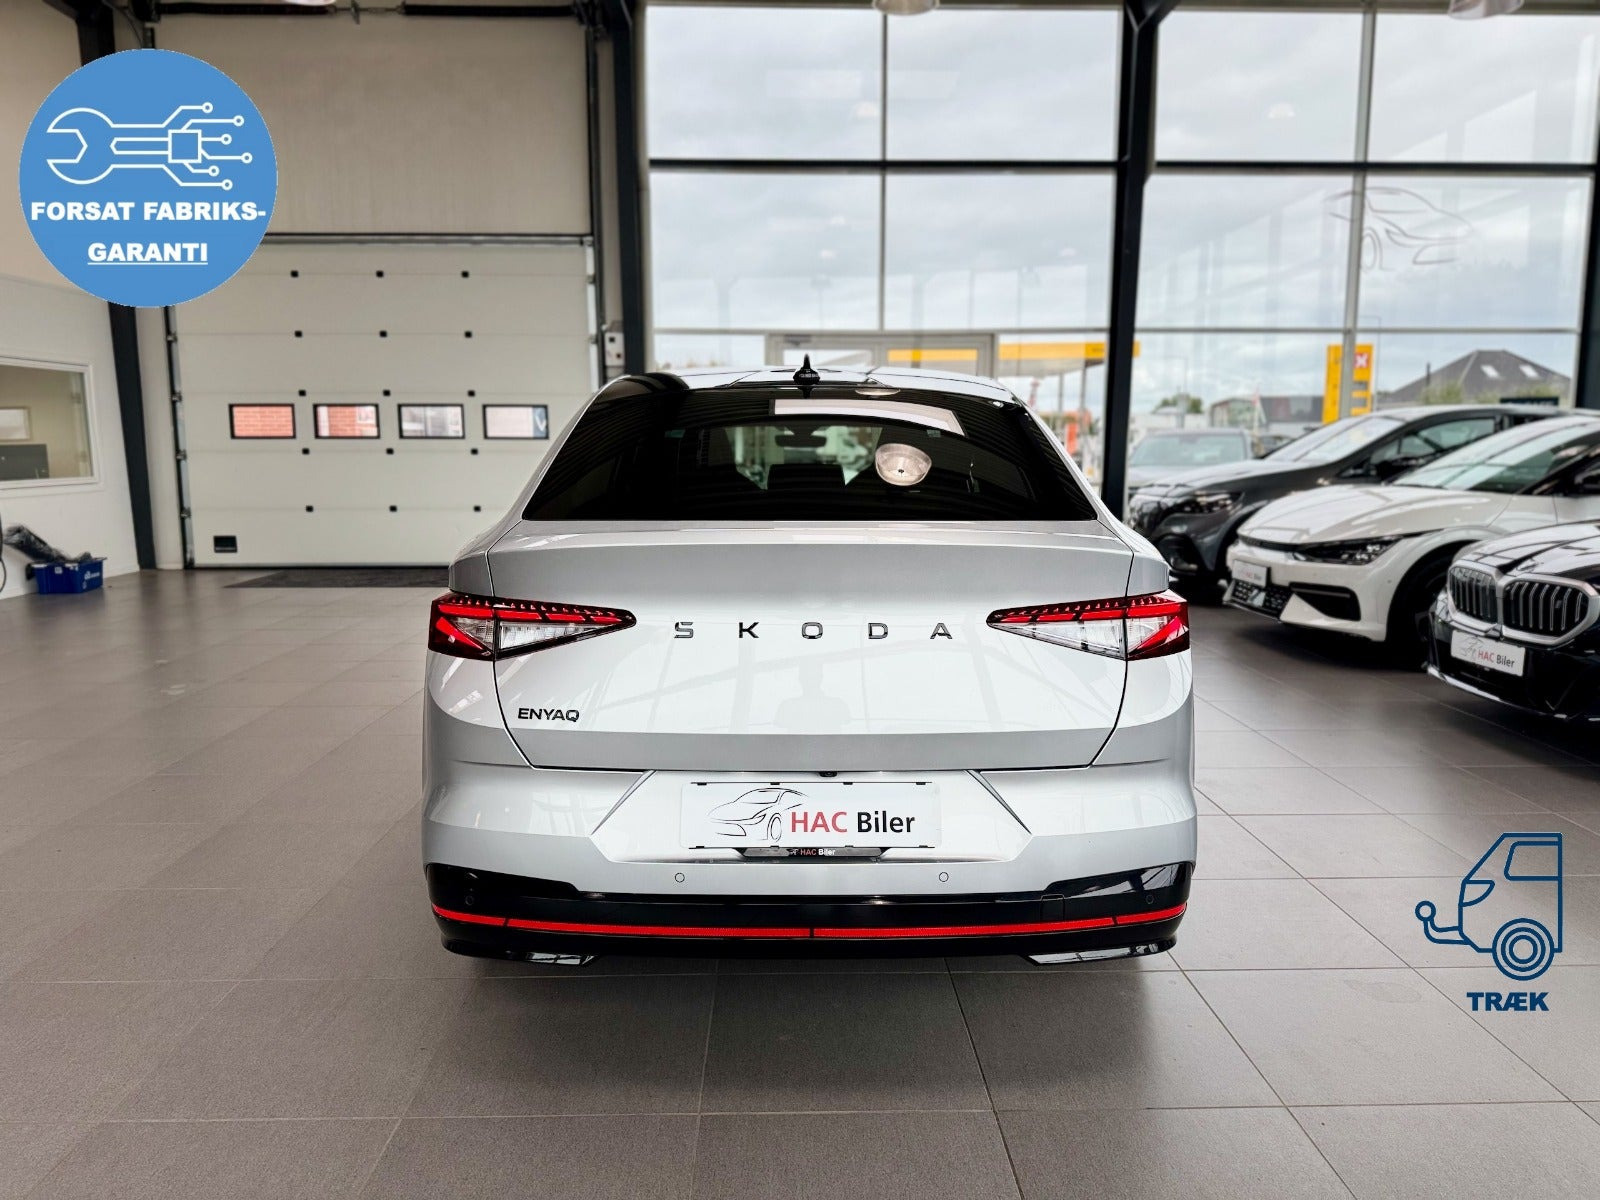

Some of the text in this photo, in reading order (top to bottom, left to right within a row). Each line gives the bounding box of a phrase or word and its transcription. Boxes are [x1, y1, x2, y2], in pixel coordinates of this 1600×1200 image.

[674, 621, 953, 640] SKODA
[1477, 649, 1515, 668] HAC Biler
[517, 707, 580, 723] ENYAQ
[791, 810, 915, 833] HAC Biler
[800, 848, 836, 856] HAC Biler
